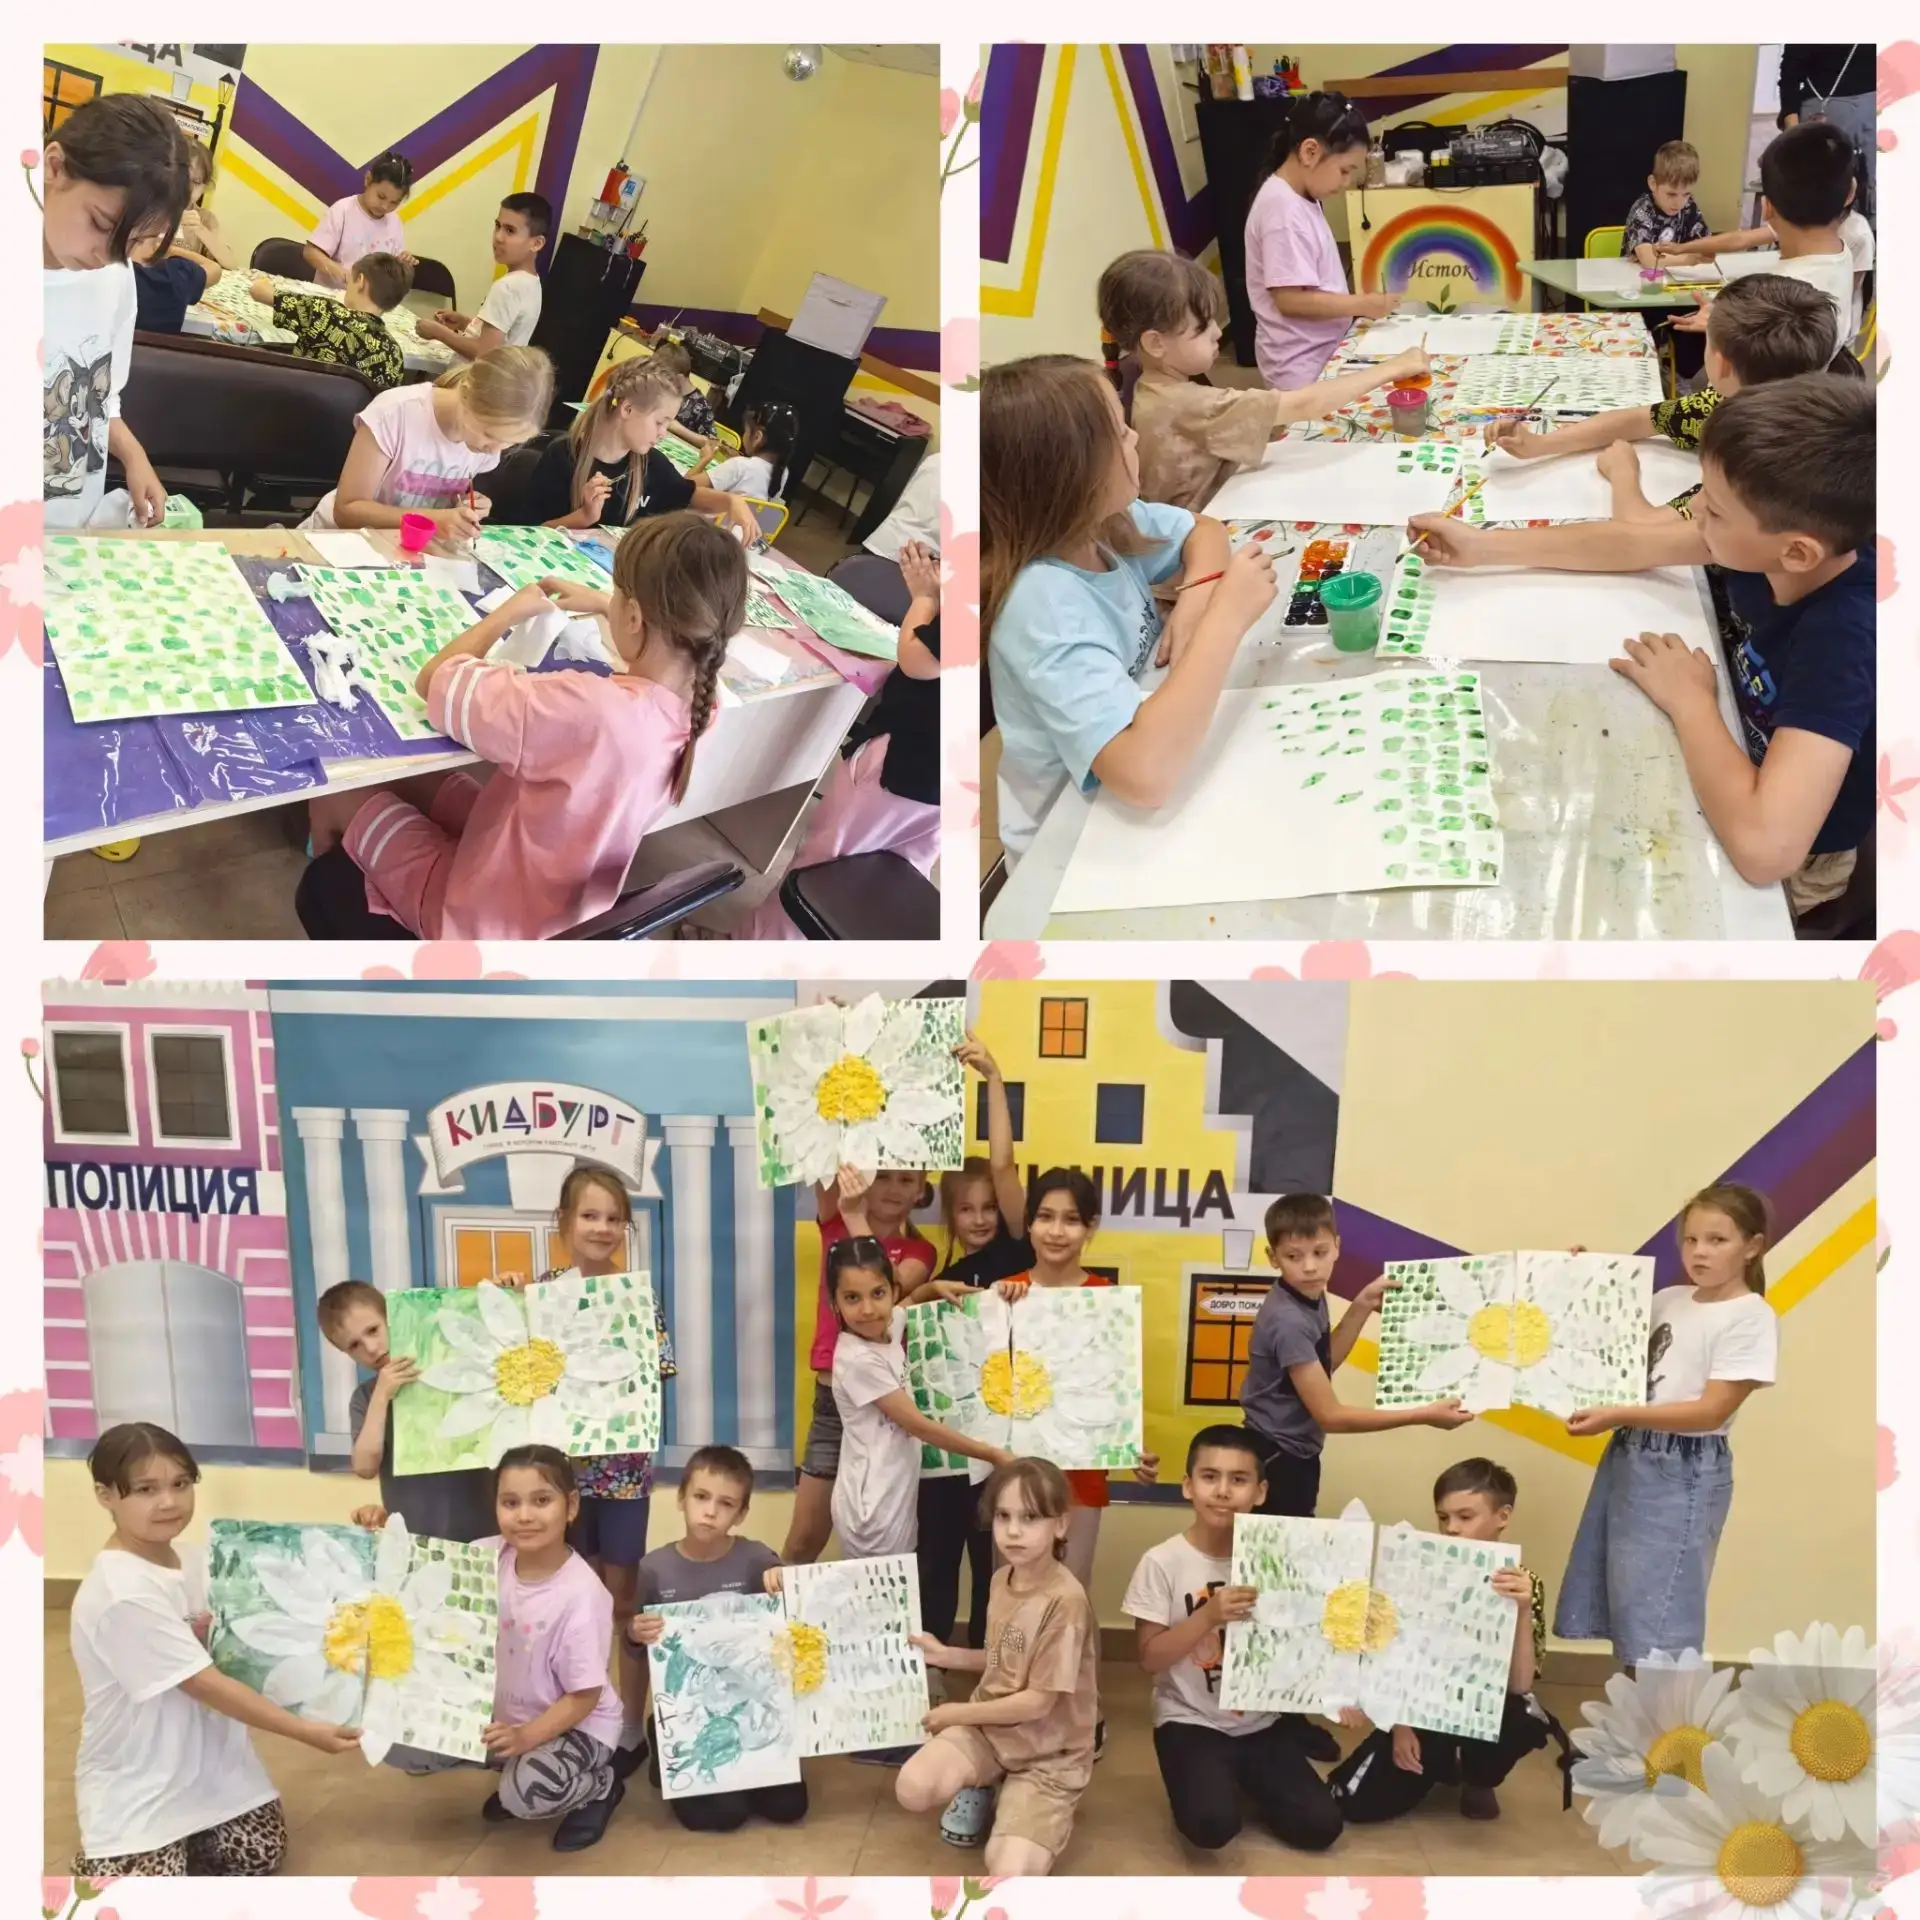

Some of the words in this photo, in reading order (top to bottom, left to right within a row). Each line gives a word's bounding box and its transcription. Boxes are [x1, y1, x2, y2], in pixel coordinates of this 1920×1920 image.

[1408, 259, 1479, 282] Исток
[445, 1091, 635, 1147] КИДБУРГ
[46, 1161, 260, 1223] ПОЛИЦИЯ
[1210, 1299, 1236, 1309] ДОБРО
